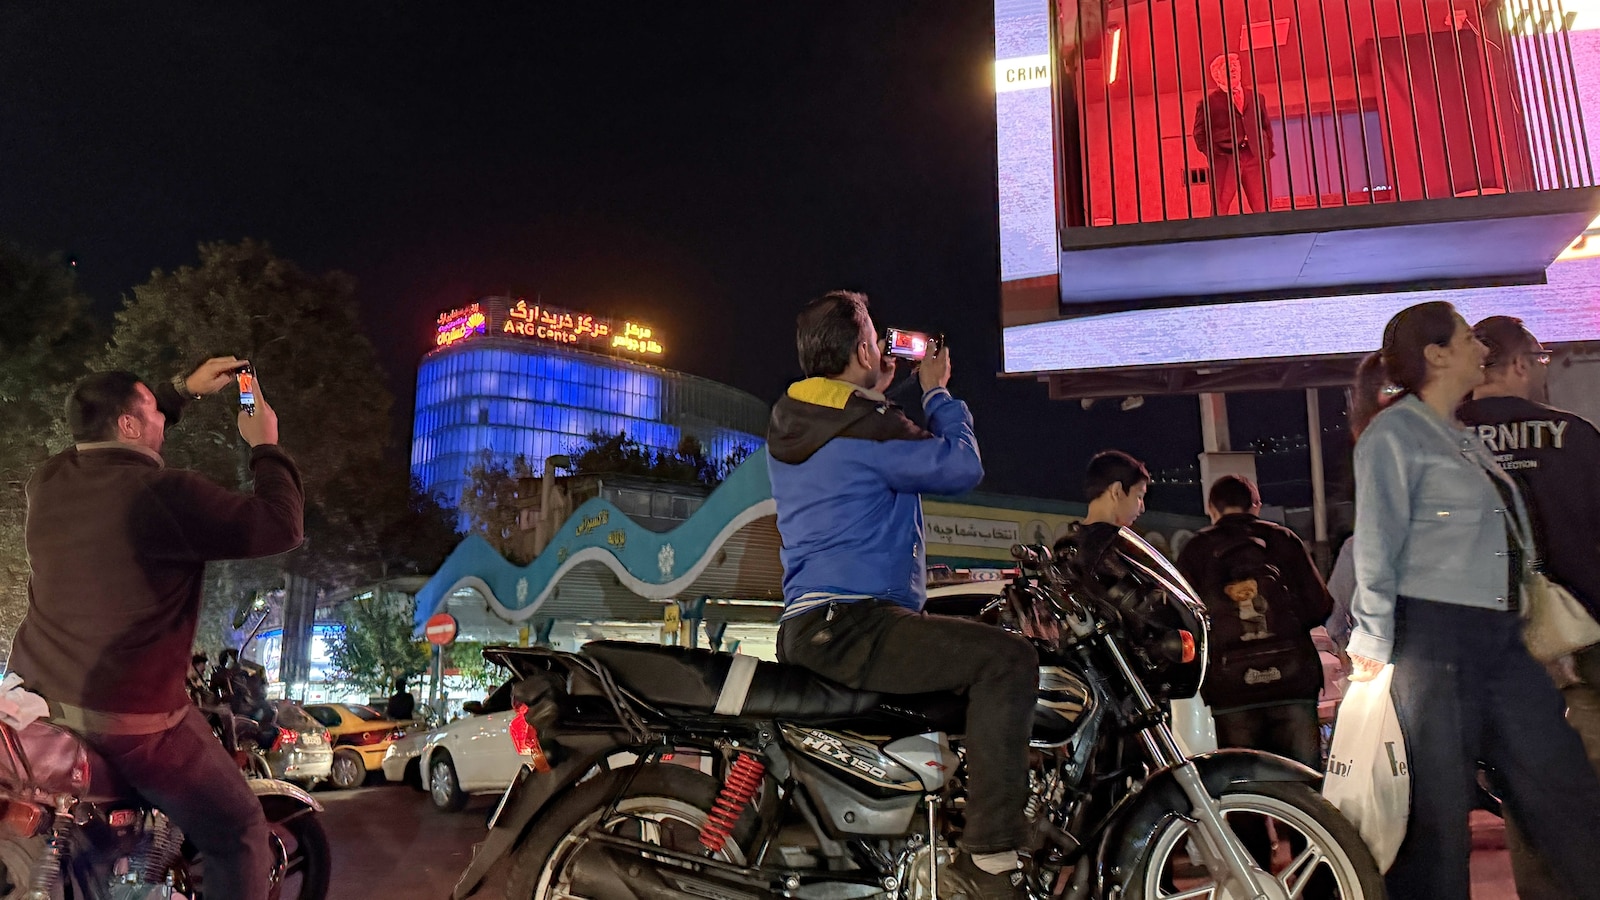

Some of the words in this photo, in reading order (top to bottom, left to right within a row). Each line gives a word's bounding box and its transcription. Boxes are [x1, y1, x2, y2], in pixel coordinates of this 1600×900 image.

[1005, 65, 1047, 83] CRIM
[509, 299, 540, 323] ارگ
[541, 310, 574, 330] خرید
[503, 319, 535, 336] ARG
[574, 316, 608, 338] مرکز
[1466, 420, 1568, 451] RNITY
[1500, 460, 1538, 470] LECTION
[954, 523, 977, 537] شما
[979, 527, 1018, 542] انتخاب
[802, 736, 851, 764] HLX
[850, 757, 887, 779] 150
[1327, 754, 1353, 778] ini
